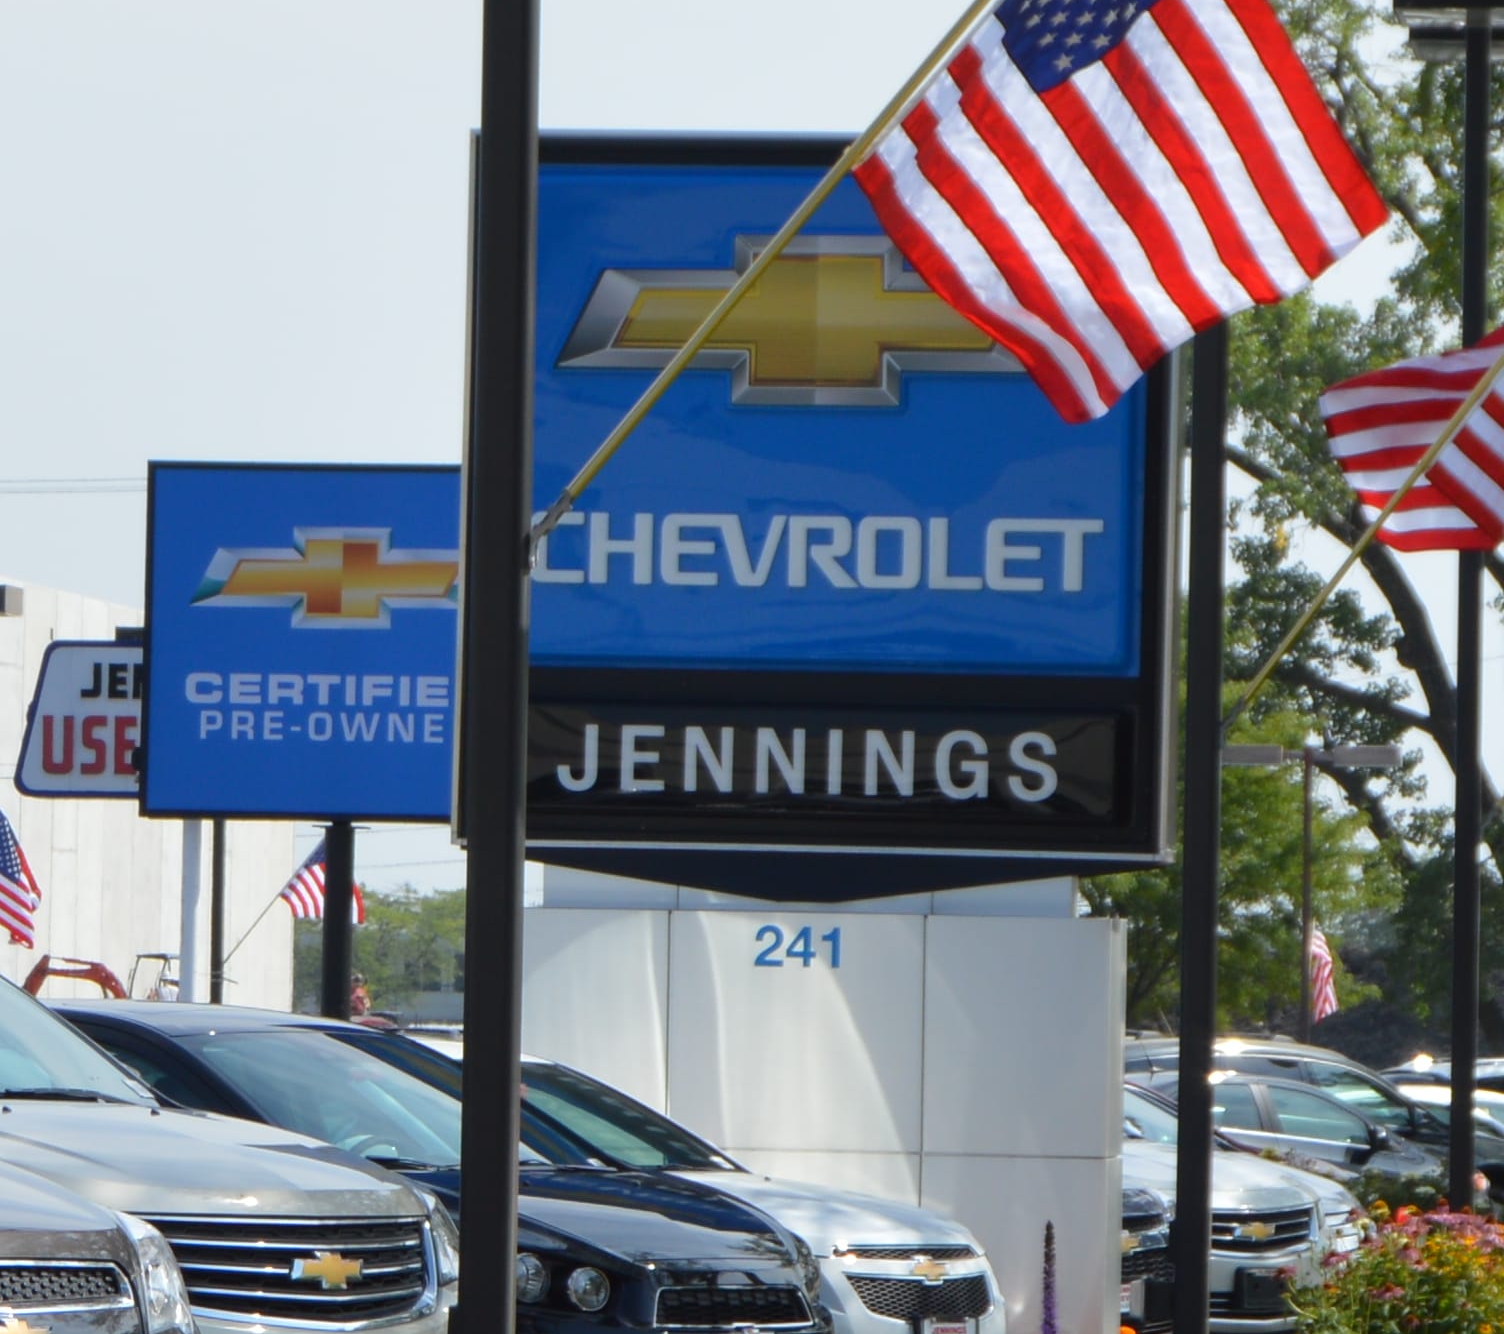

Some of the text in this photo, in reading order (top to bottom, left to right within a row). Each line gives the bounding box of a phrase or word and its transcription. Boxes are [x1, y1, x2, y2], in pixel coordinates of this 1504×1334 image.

[529, 511, 1104, 592] CHEVROLET
[185, 672, 449, 707] CERTIFIE
[42, 715, 138, 775] USE
[200, 710, 445, 743] PRE-OWNE
[556, 723, 1059, 802] JENNINGS
[754, 924, 841, 968] 241
